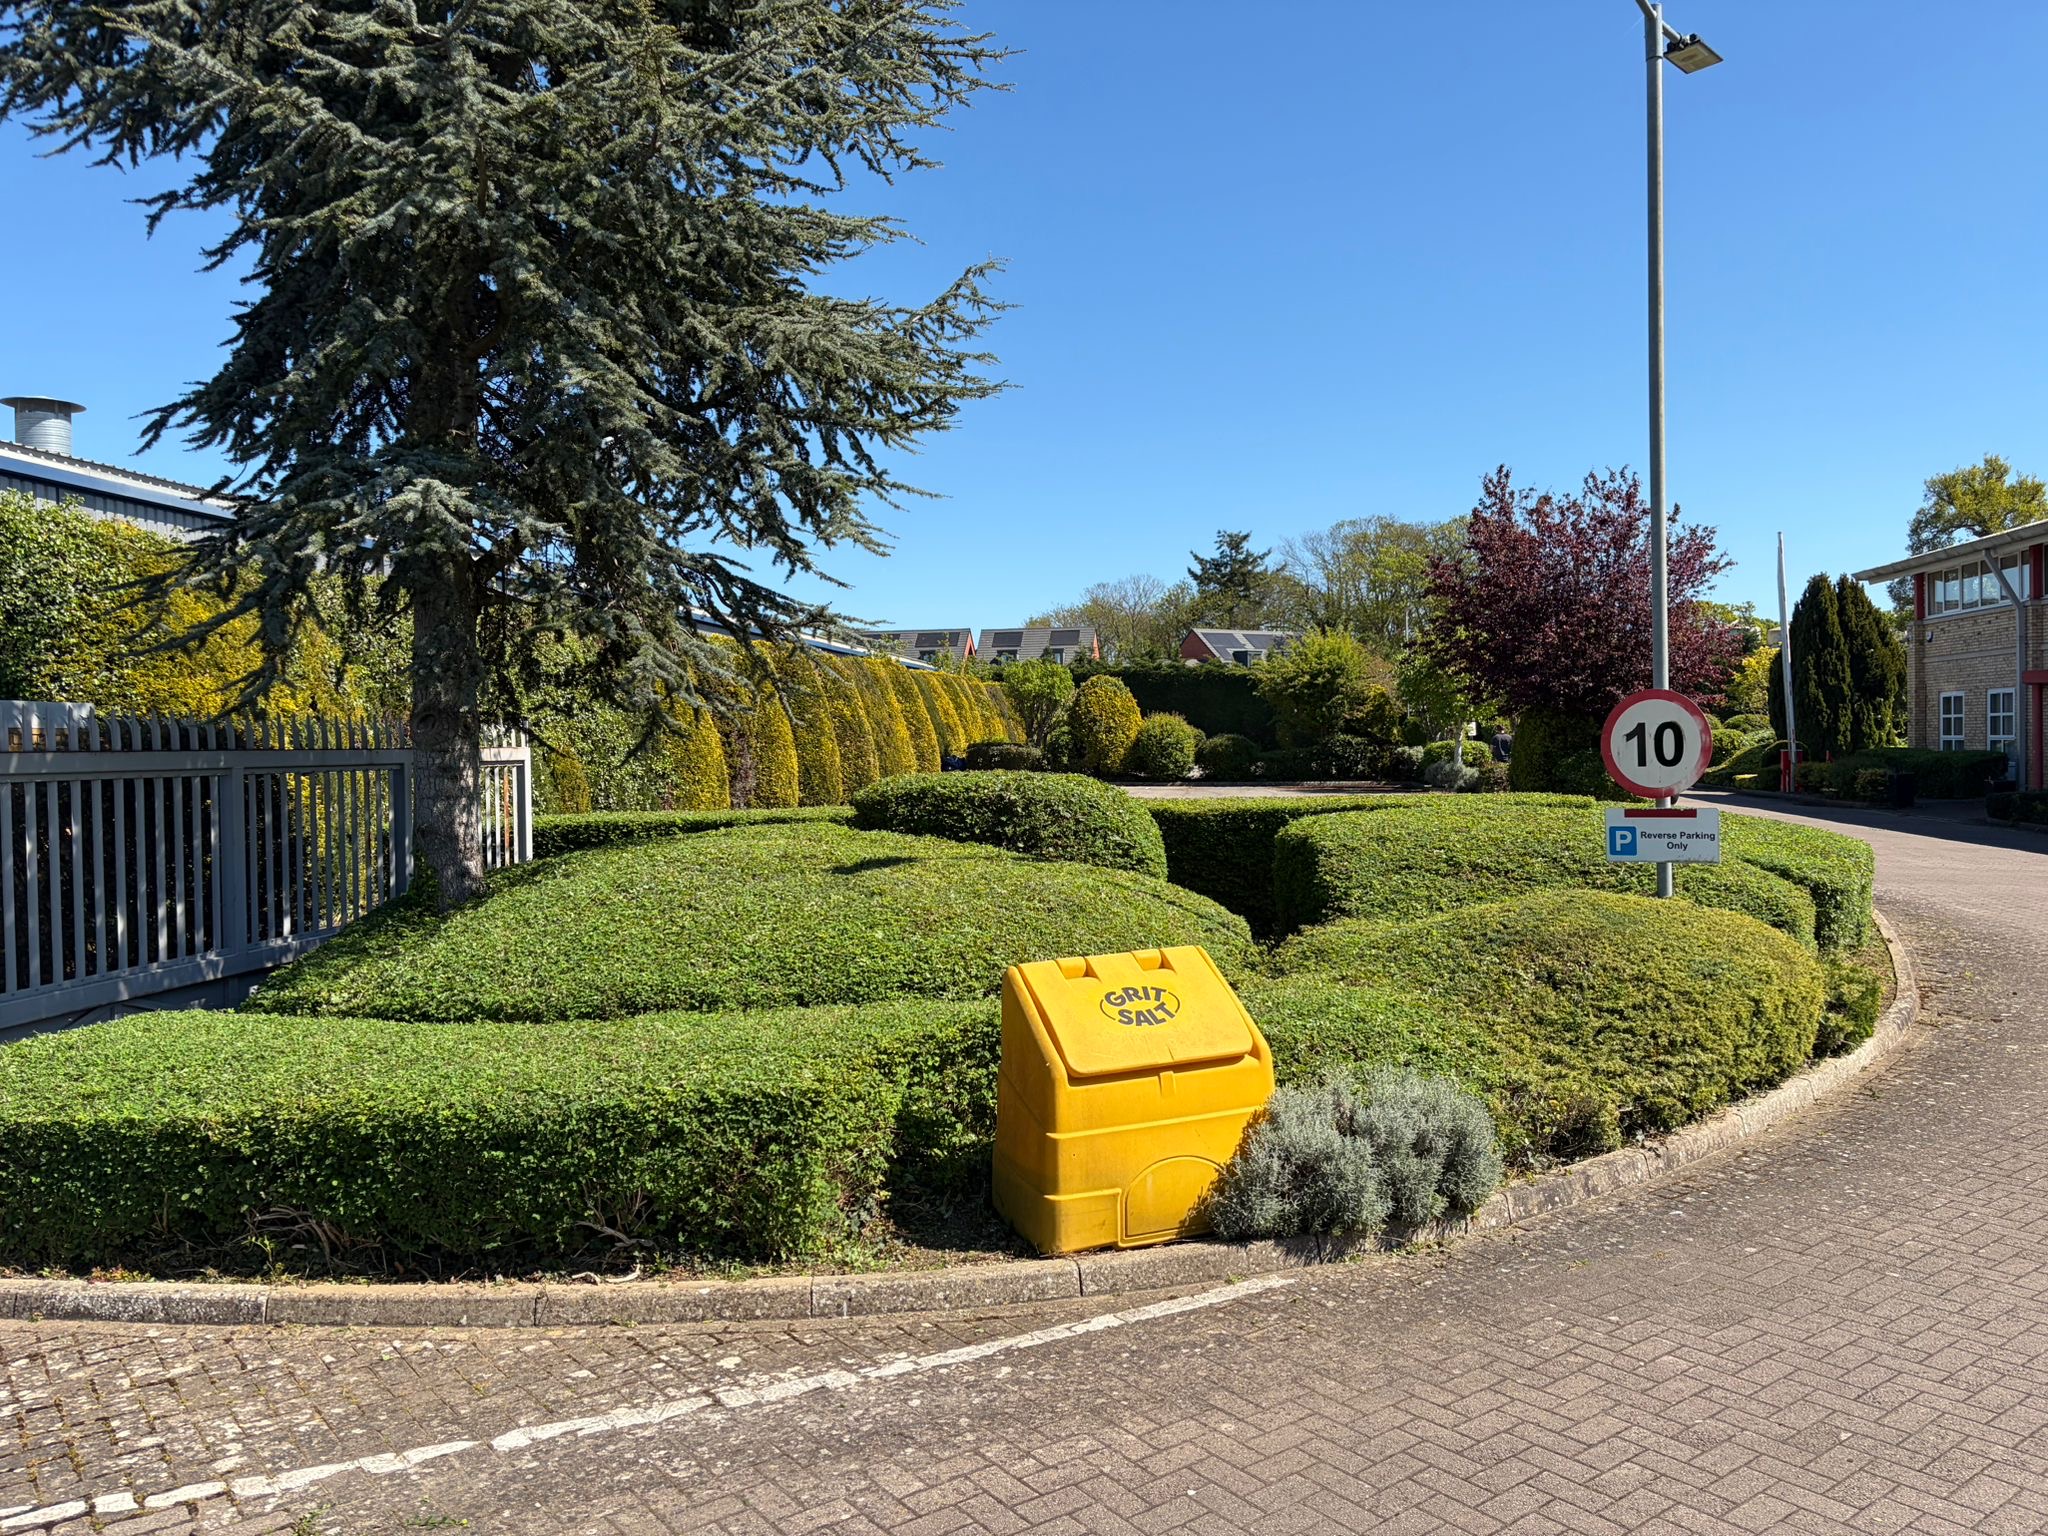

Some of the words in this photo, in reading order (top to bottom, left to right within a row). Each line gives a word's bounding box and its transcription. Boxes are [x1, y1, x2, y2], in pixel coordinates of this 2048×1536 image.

[1624, 721, 1685, 768] 10
[1615, 830, 1632, 852] P
[1640, 831, 1677, 840] Reverse
[1679, 831, 1716, 842] Parking
[1666, 841, 1688, 851] Only
[1105, 986, 1168, 1007] GRIT
[1117, 1001, 1176, 1027] SALT
